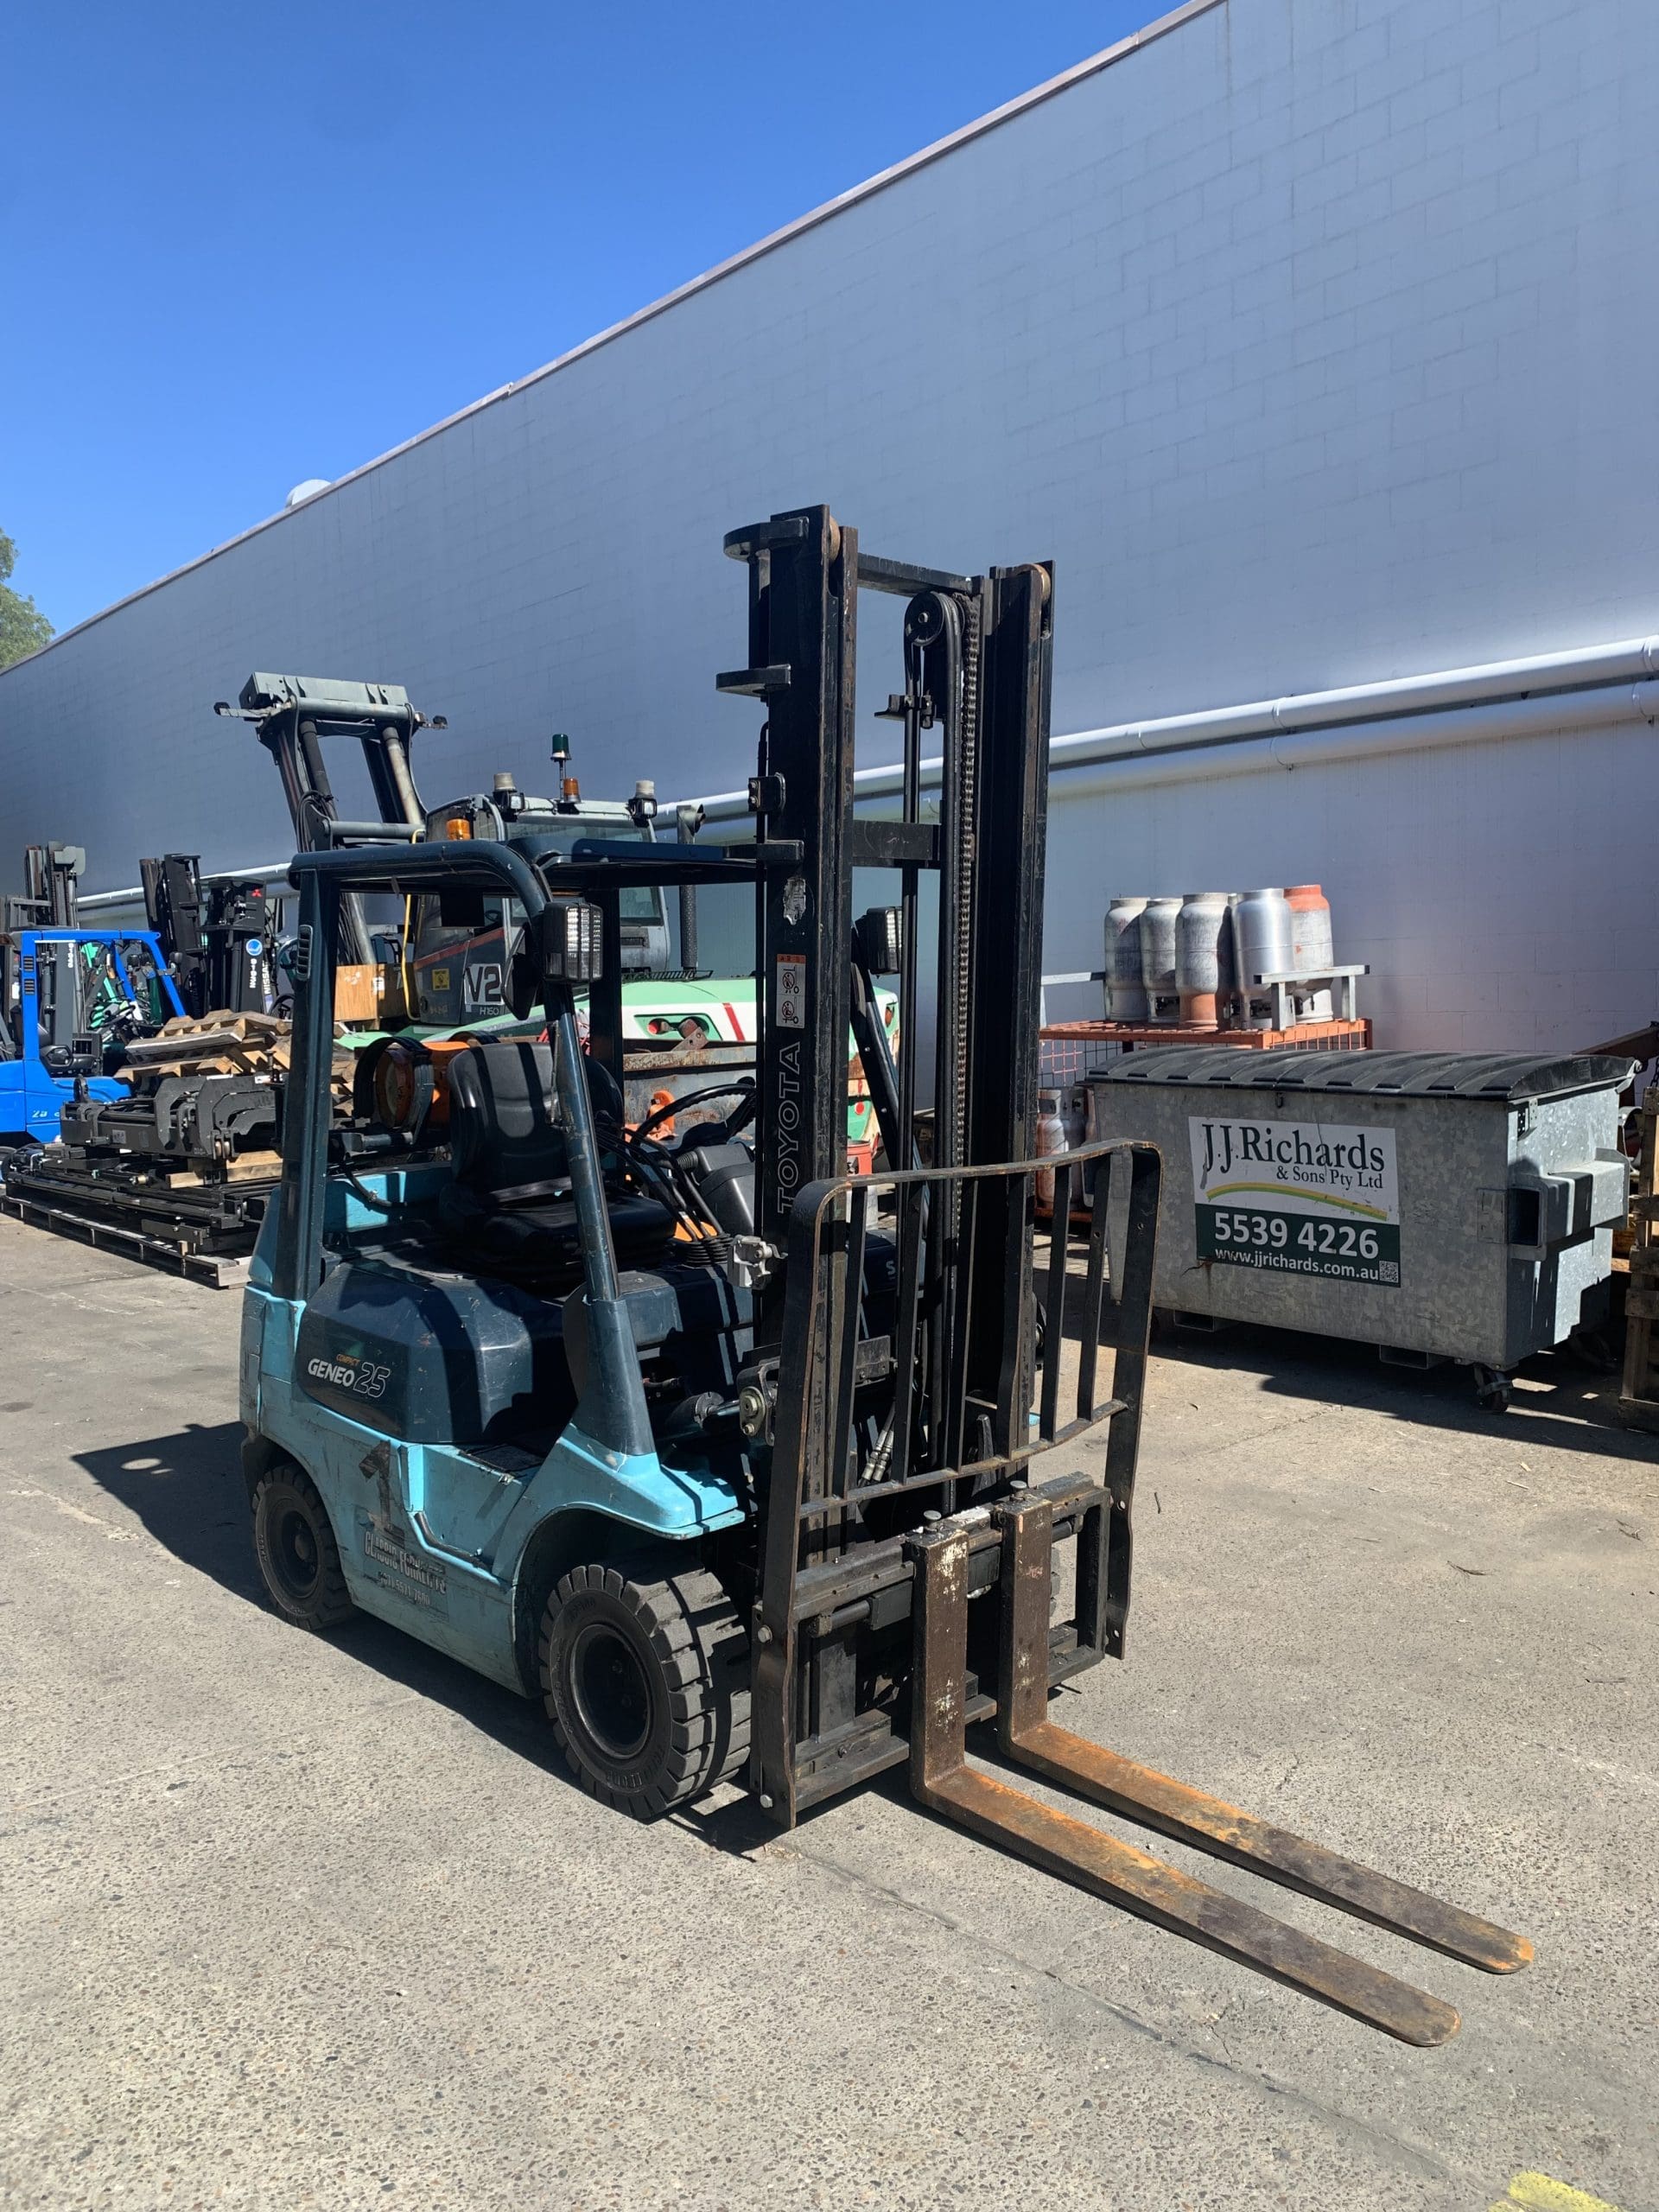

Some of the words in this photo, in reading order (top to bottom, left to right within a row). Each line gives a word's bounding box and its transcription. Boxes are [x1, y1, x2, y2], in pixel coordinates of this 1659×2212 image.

[465, 965, 501, 1002] V2
[778, 1041, 800, 1214] TOYOTA
[1276, 1166, 1289, 1180] &
[1293, 1166, 1325, 1184] Sons
[1330, 1169, 1353, 1191] Pty
[1357, 1172, 1383, 1189] Ltd
[1215, 1212, 1287, 1248] 5539
[1297, 1222, 1379, 1259] 4226
[1215, 1248, 1379, 1281] www.jjrichards.com.au
[308, 1358, 355, 1387] GENEO
[353, 1362, 391, 1398] 25
